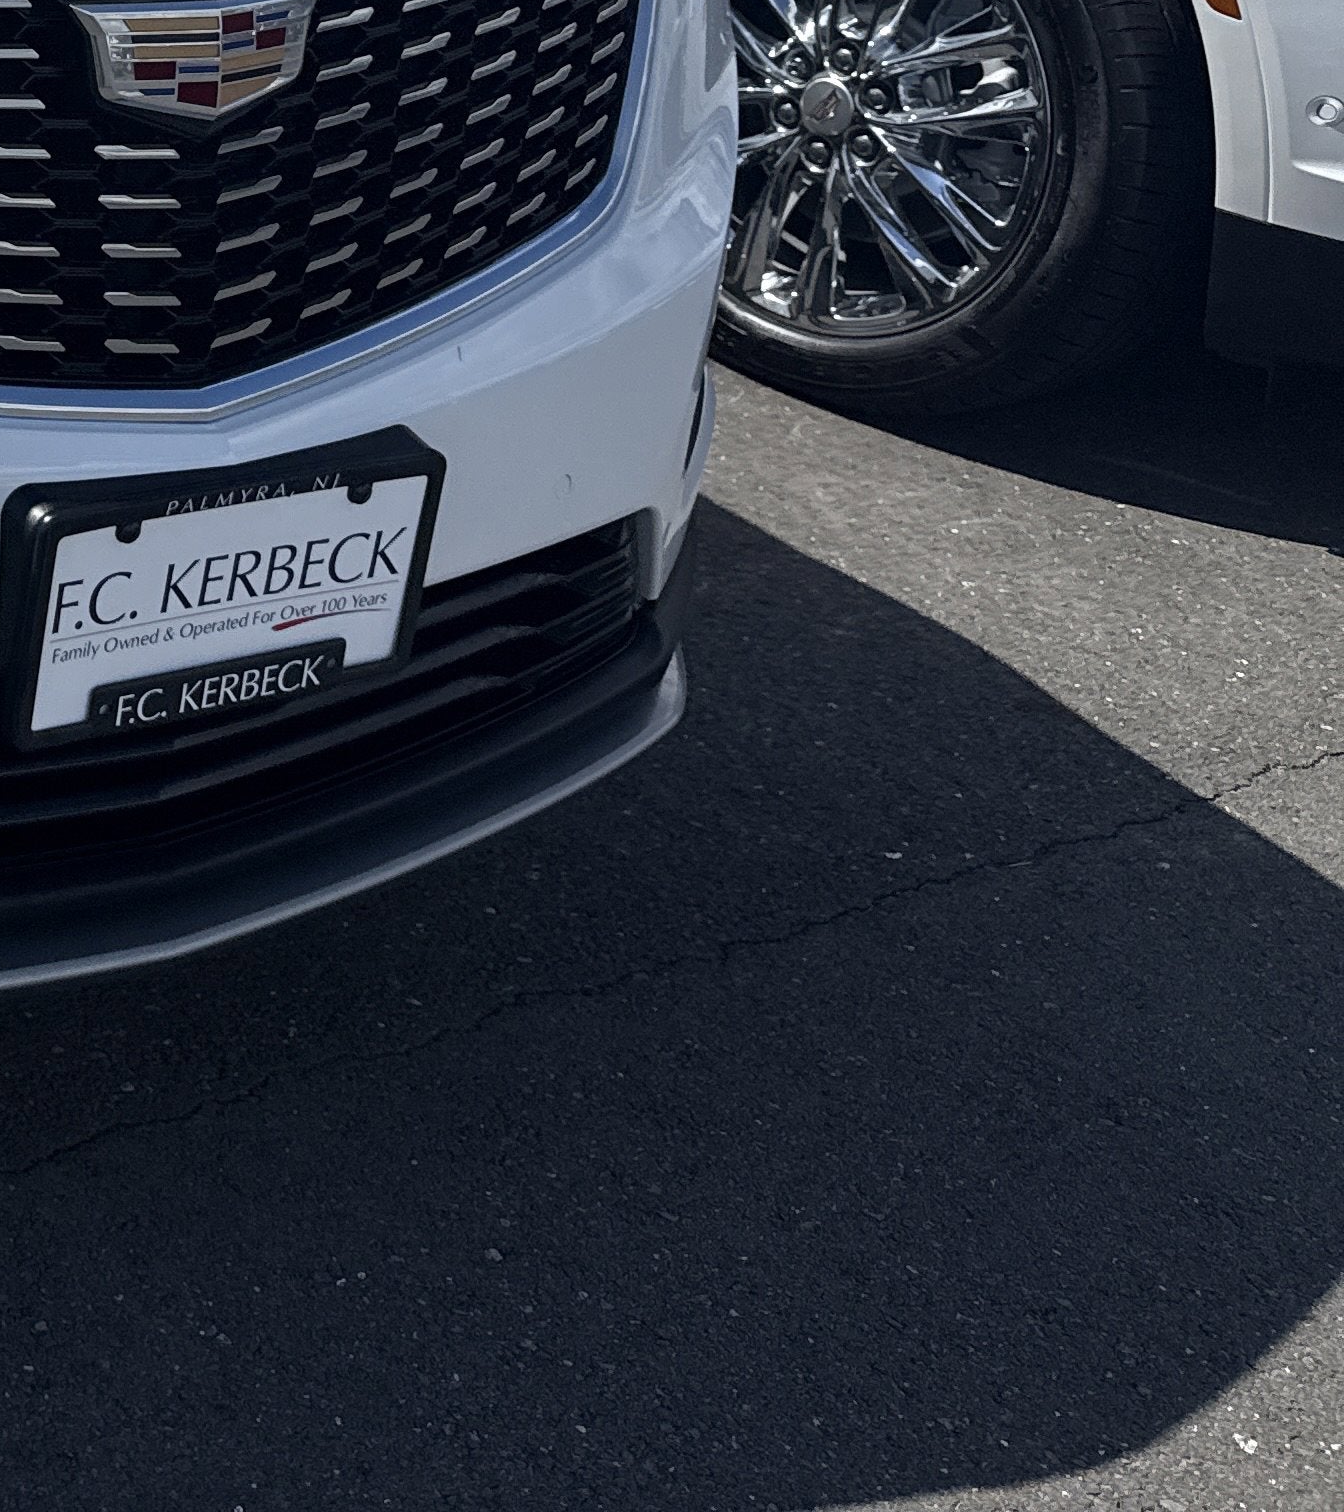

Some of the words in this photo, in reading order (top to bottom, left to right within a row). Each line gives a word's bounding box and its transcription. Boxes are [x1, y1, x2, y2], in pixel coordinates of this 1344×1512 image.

[52, 570, 139, 635] F.C.
[160, 527, 408, 614] KERBECK
[51, 639, 100, 665] Family
[103, 628, 159, 654] Owned
[163, 627, 175, 642] &
[179, 611, 249, 639] Operated
[252, 609, 277, 626] For
[280, 603, 317, 621] Over
[320, 596, 347, 614] 100
[351, 590, 389, 609] Years
[115, 687, 167, 727] F.C.
[179, 655, 325, 714] KERBECK
